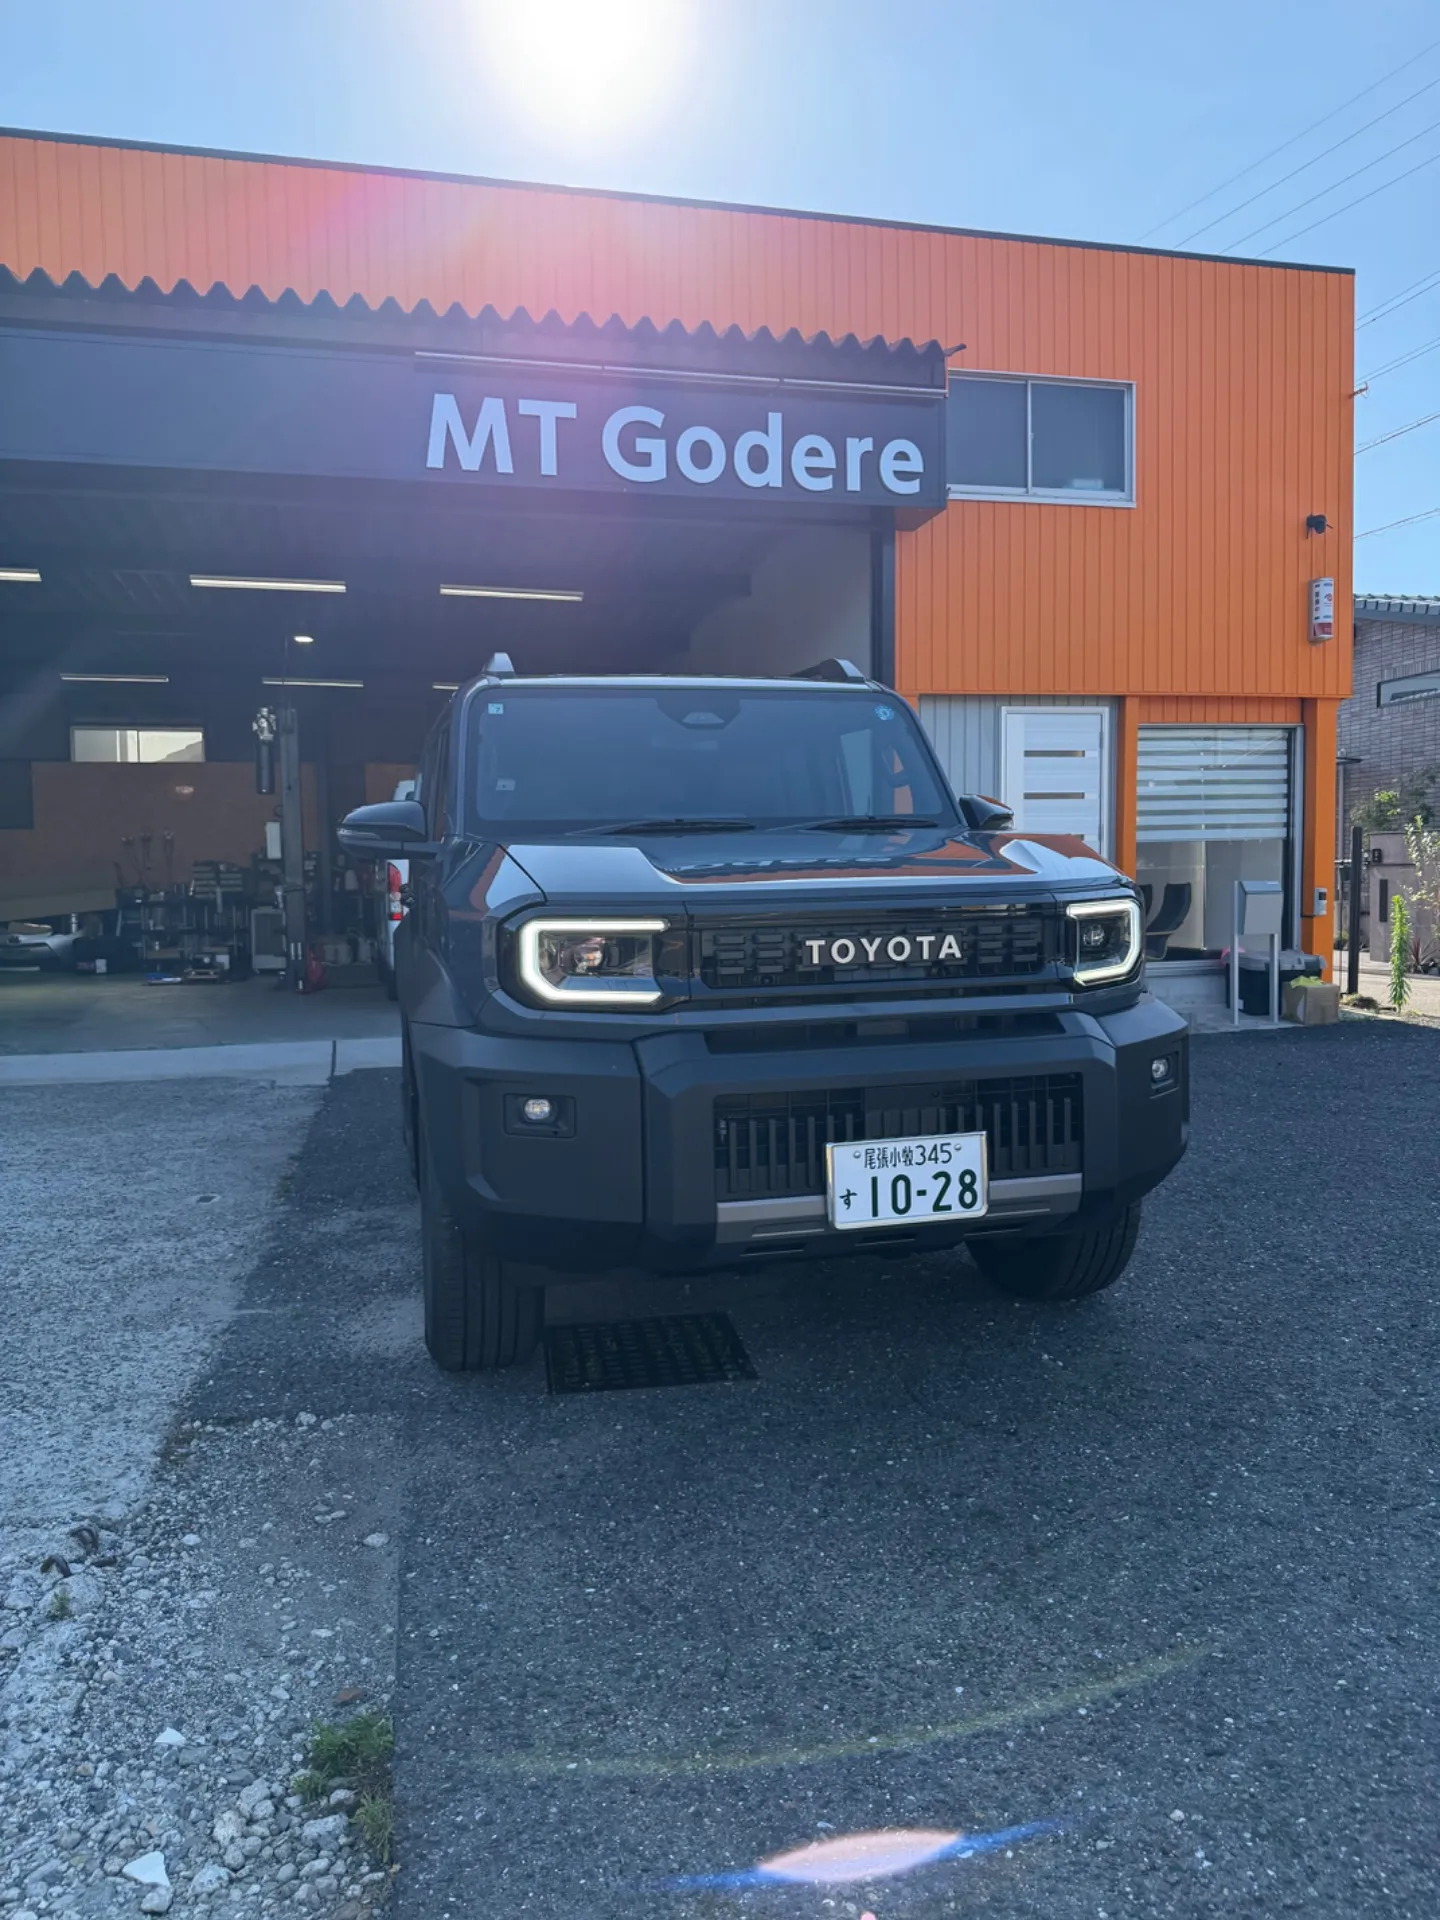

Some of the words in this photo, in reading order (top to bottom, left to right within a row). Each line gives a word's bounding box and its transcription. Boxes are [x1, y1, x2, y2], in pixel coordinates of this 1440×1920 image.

[426, 393, 577, 476] MT
[602, 405, 925, 495] Godere
[805, 934, 962, 964] TOYOTA
[839, 1188, 858, 1210] す
[871, 1168, 978, 1218] 10-28
